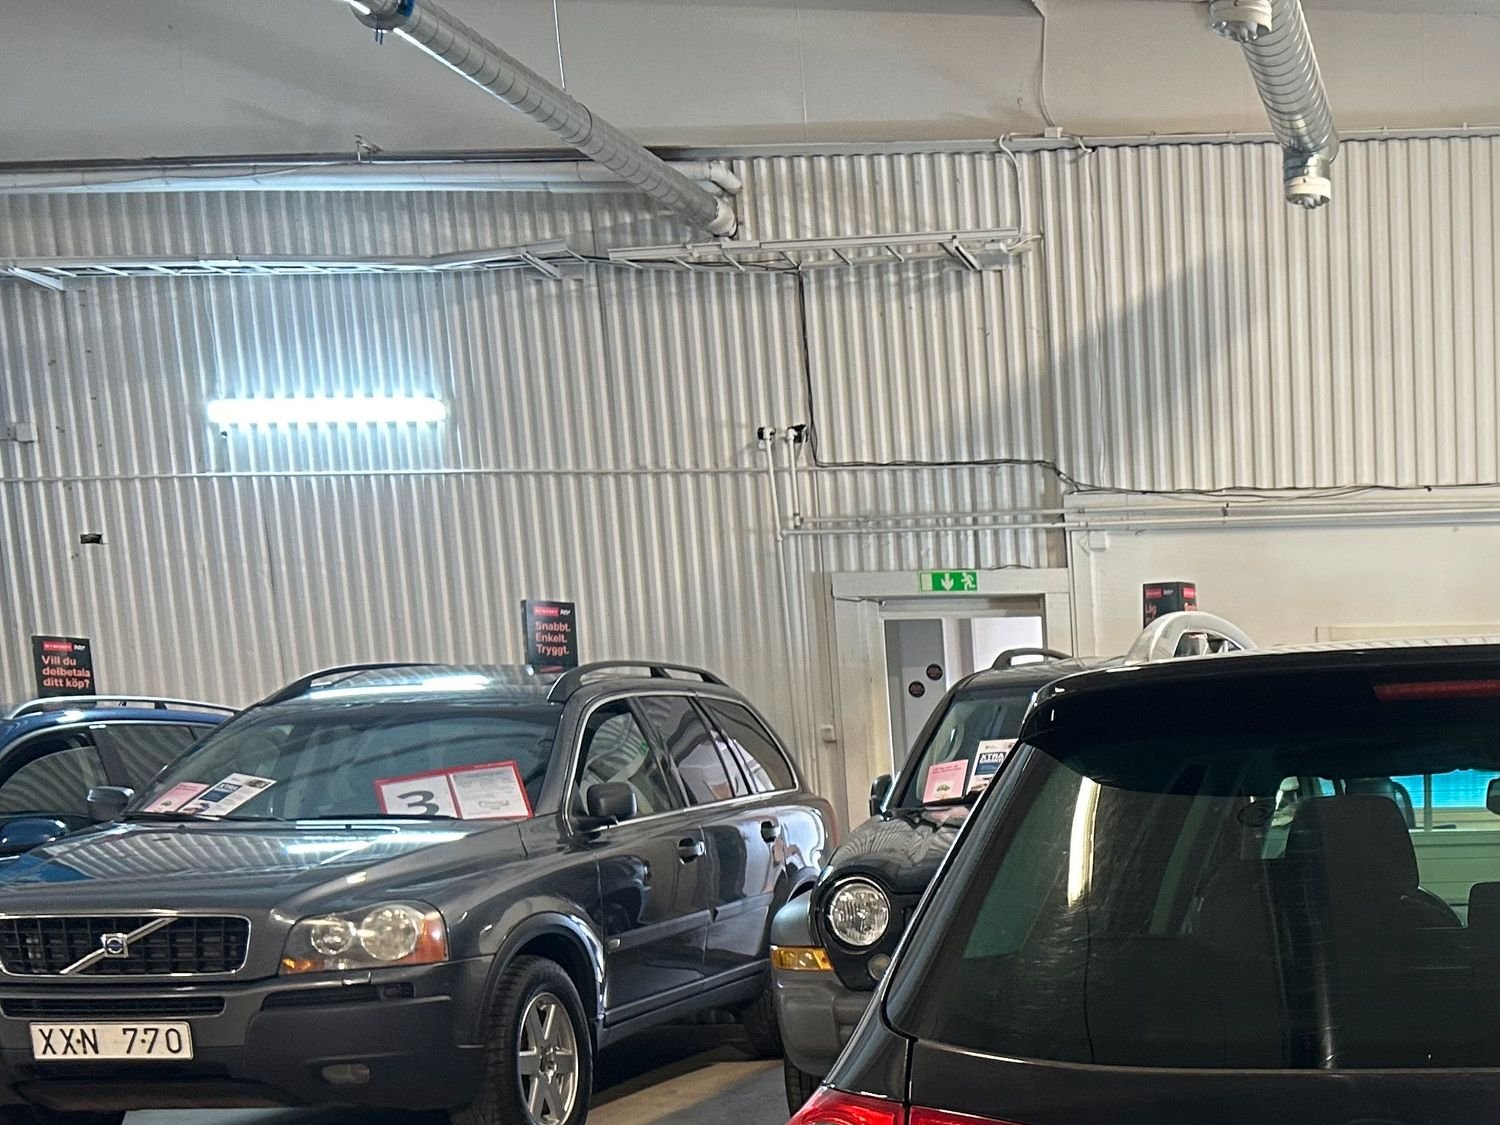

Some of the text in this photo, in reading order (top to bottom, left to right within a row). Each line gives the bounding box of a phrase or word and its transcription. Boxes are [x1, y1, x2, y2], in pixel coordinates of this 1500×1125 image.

[535, 621, 571, 632] Snabbt.
[536, 632, 568, 643] Enkelt.
[536, 644, 570, 657] Tryggt.
[42, 655, 77, 666] Vill du
[42, 666, 91, 678] delbetala
[43, 677, 90, 690] ditt köp?
[397, 790, 440, 815] 3
[38, 1028, 183, 1055] XXN 770
